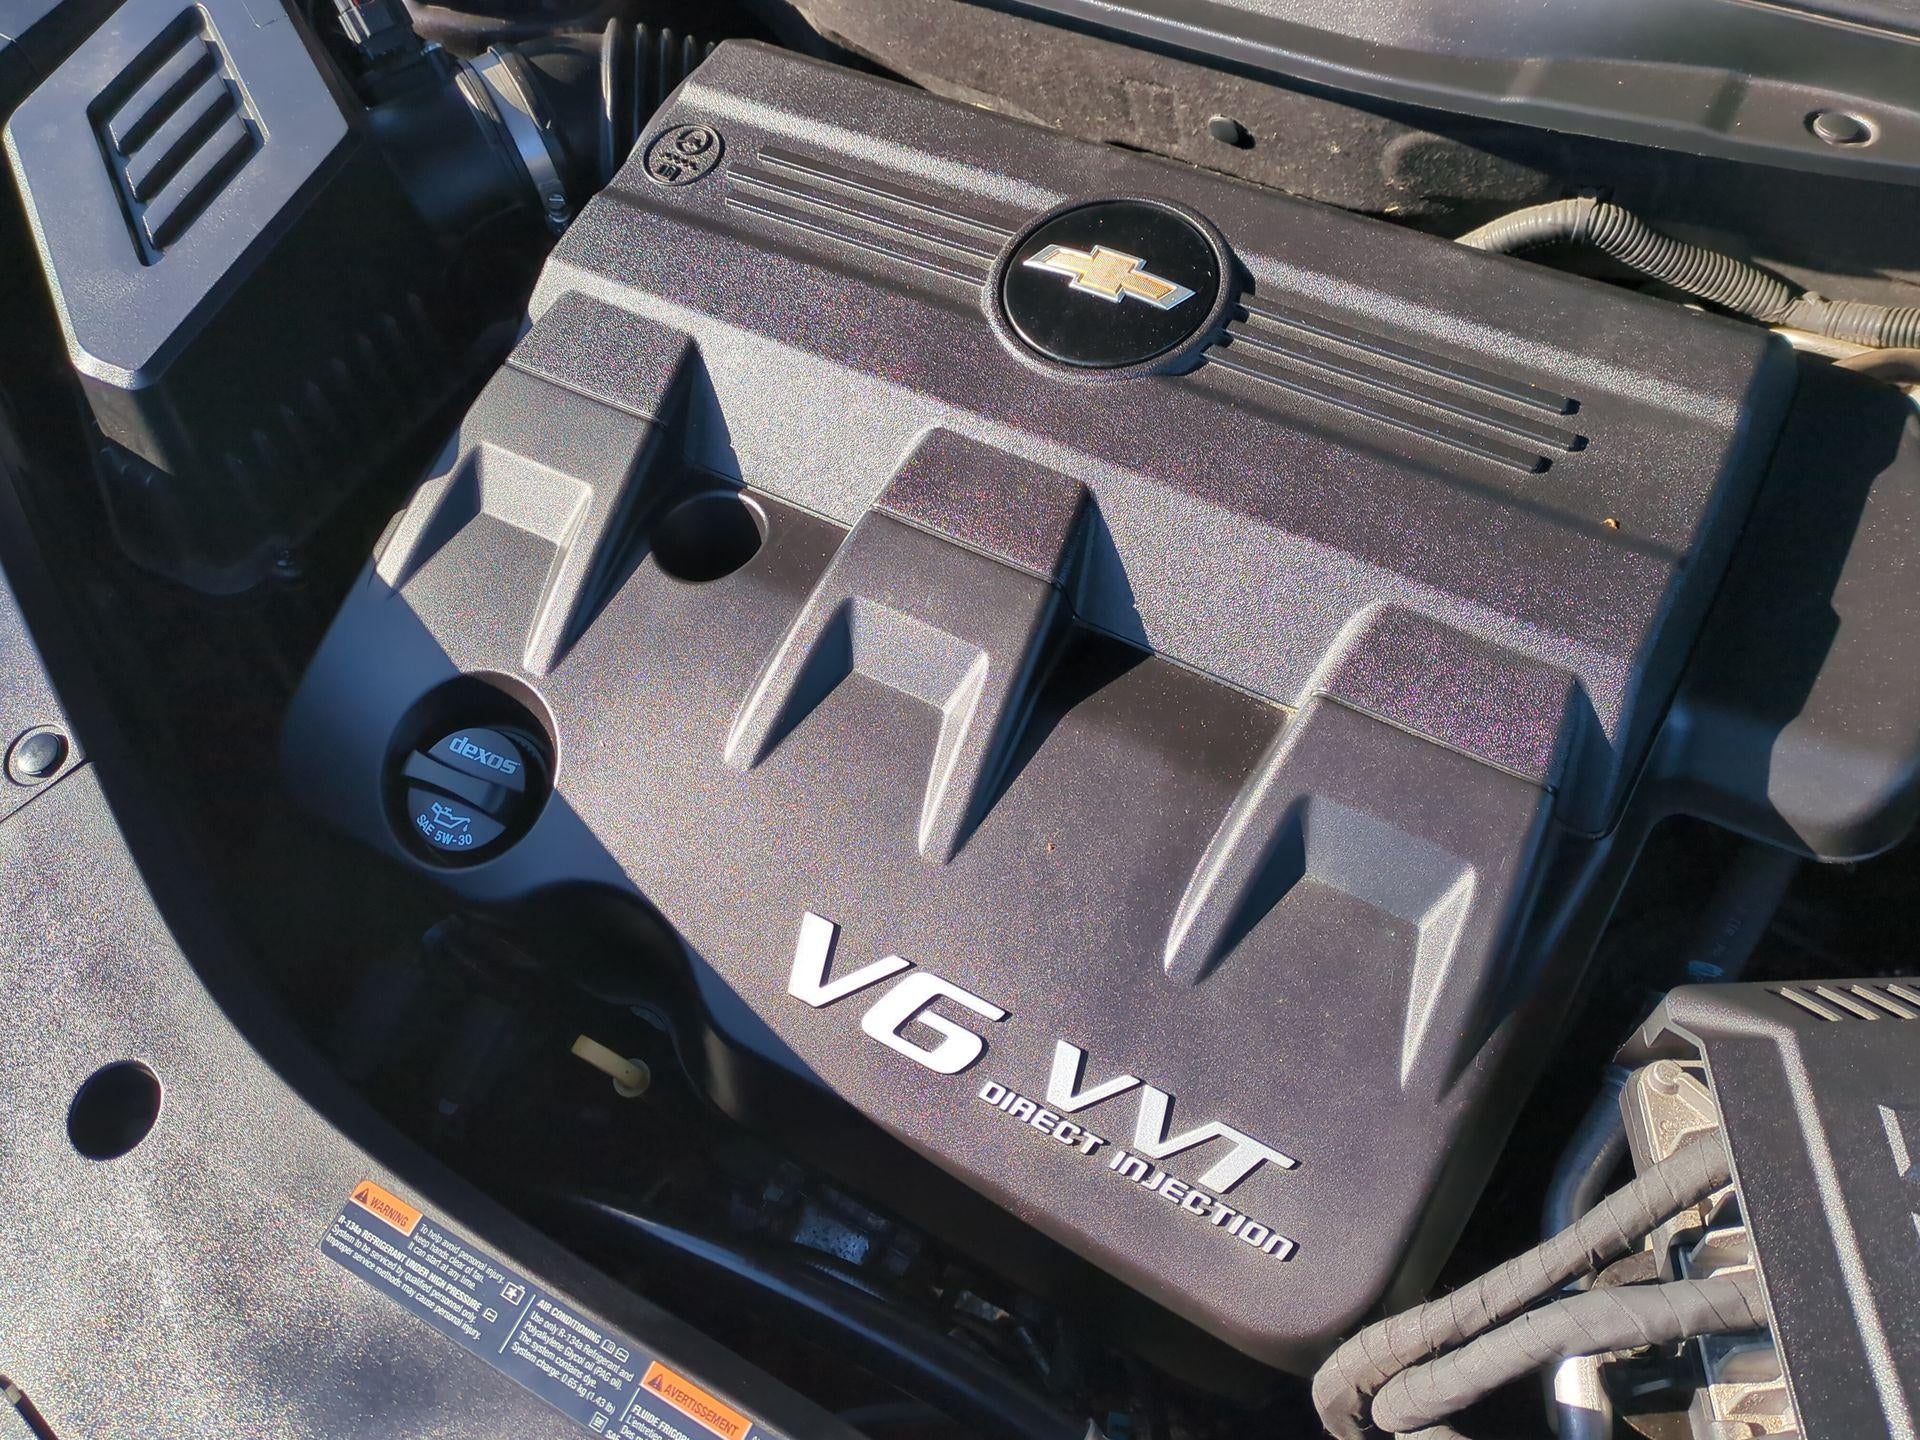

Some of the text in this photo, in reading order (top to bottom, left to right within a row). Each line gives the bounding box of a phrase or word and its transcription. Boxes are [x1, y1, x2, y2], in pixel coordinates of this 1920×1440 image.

[417, 814, 472, 845] SAE 5W-30
[788, 910, 1297, 1194] V6 VVT
[978, 1081, 1296, 1262] DIRECT INJECTION
[369, 1197, 408, 1226] WARNING
[331, 1224, 355, 1244] System
[354, 1239, 362, 1247] to
[361, 1243, 371, 1253] be
[370, 1249, 396, 1269] serviced
[395, 1266, 405, 1276] by
[403, 1271, 431, 1293] qualified
[430, 1289, 462, 1313] personnel
[338, 1215, 481, 1311] R-134a REFRIGERANT UNDER HIGH PRESSURE
[413, 1233, 430, 1247] keep
[429, 1243, 449, 1259] hands
[449, 1256, 465, 1269] clear
[464, 1266, 472, 1274] of
[413, 1247, 425, 1257] can
[426, 1254, 440, 1266] start
[440, 1263, 448, 1271] at
[447, 1269, 460, 1280] any
[419, 1224, 428, 1233] To
[426, 1230, 442, 1244] help
[441, 1238, 460, 1253] avoid
[458, 1250, 486, 1271] personal
[325, 1234, 353, 1256] Improper
[353, 1251, 375, 1269] service
[374, 1265, 402, 1286] methods
[400, 1284, 415, 1297] may
[415, 1293, 434, 1308] cause
[433, 1304, 462, 1327] personal
[530, 1311, 634, 1381] Use only R-134a Refrigerant and
[537, 1299, 601, 1343] AIR CONDITIONING
[518, 1331, 532, 1344] The
[529, 1340, 555, 1361] system
[554, 1356, 584, 1378] contains
[523, 1322, 564, 1352] Polyalkylene
[563, 1347, 585, 1366] Glycol
[584, 1360, 594, 1370] oil
[593, 1366, 611, 1381] (PAG
[510, 1342, 537, 1363] System
[560, 1374, 578, 1389] 0.65
[576, 1384, 587, 1396] kg
[585, 1391, 606, 1408] (1.43
[604, 1402, 616, 1414] lb)
[620, 1425, 635, 1440] Des
[632, 1404, 660, 1427] FLUIDE
[664, 1384, 740, 1437] AVERTISSEMENT
